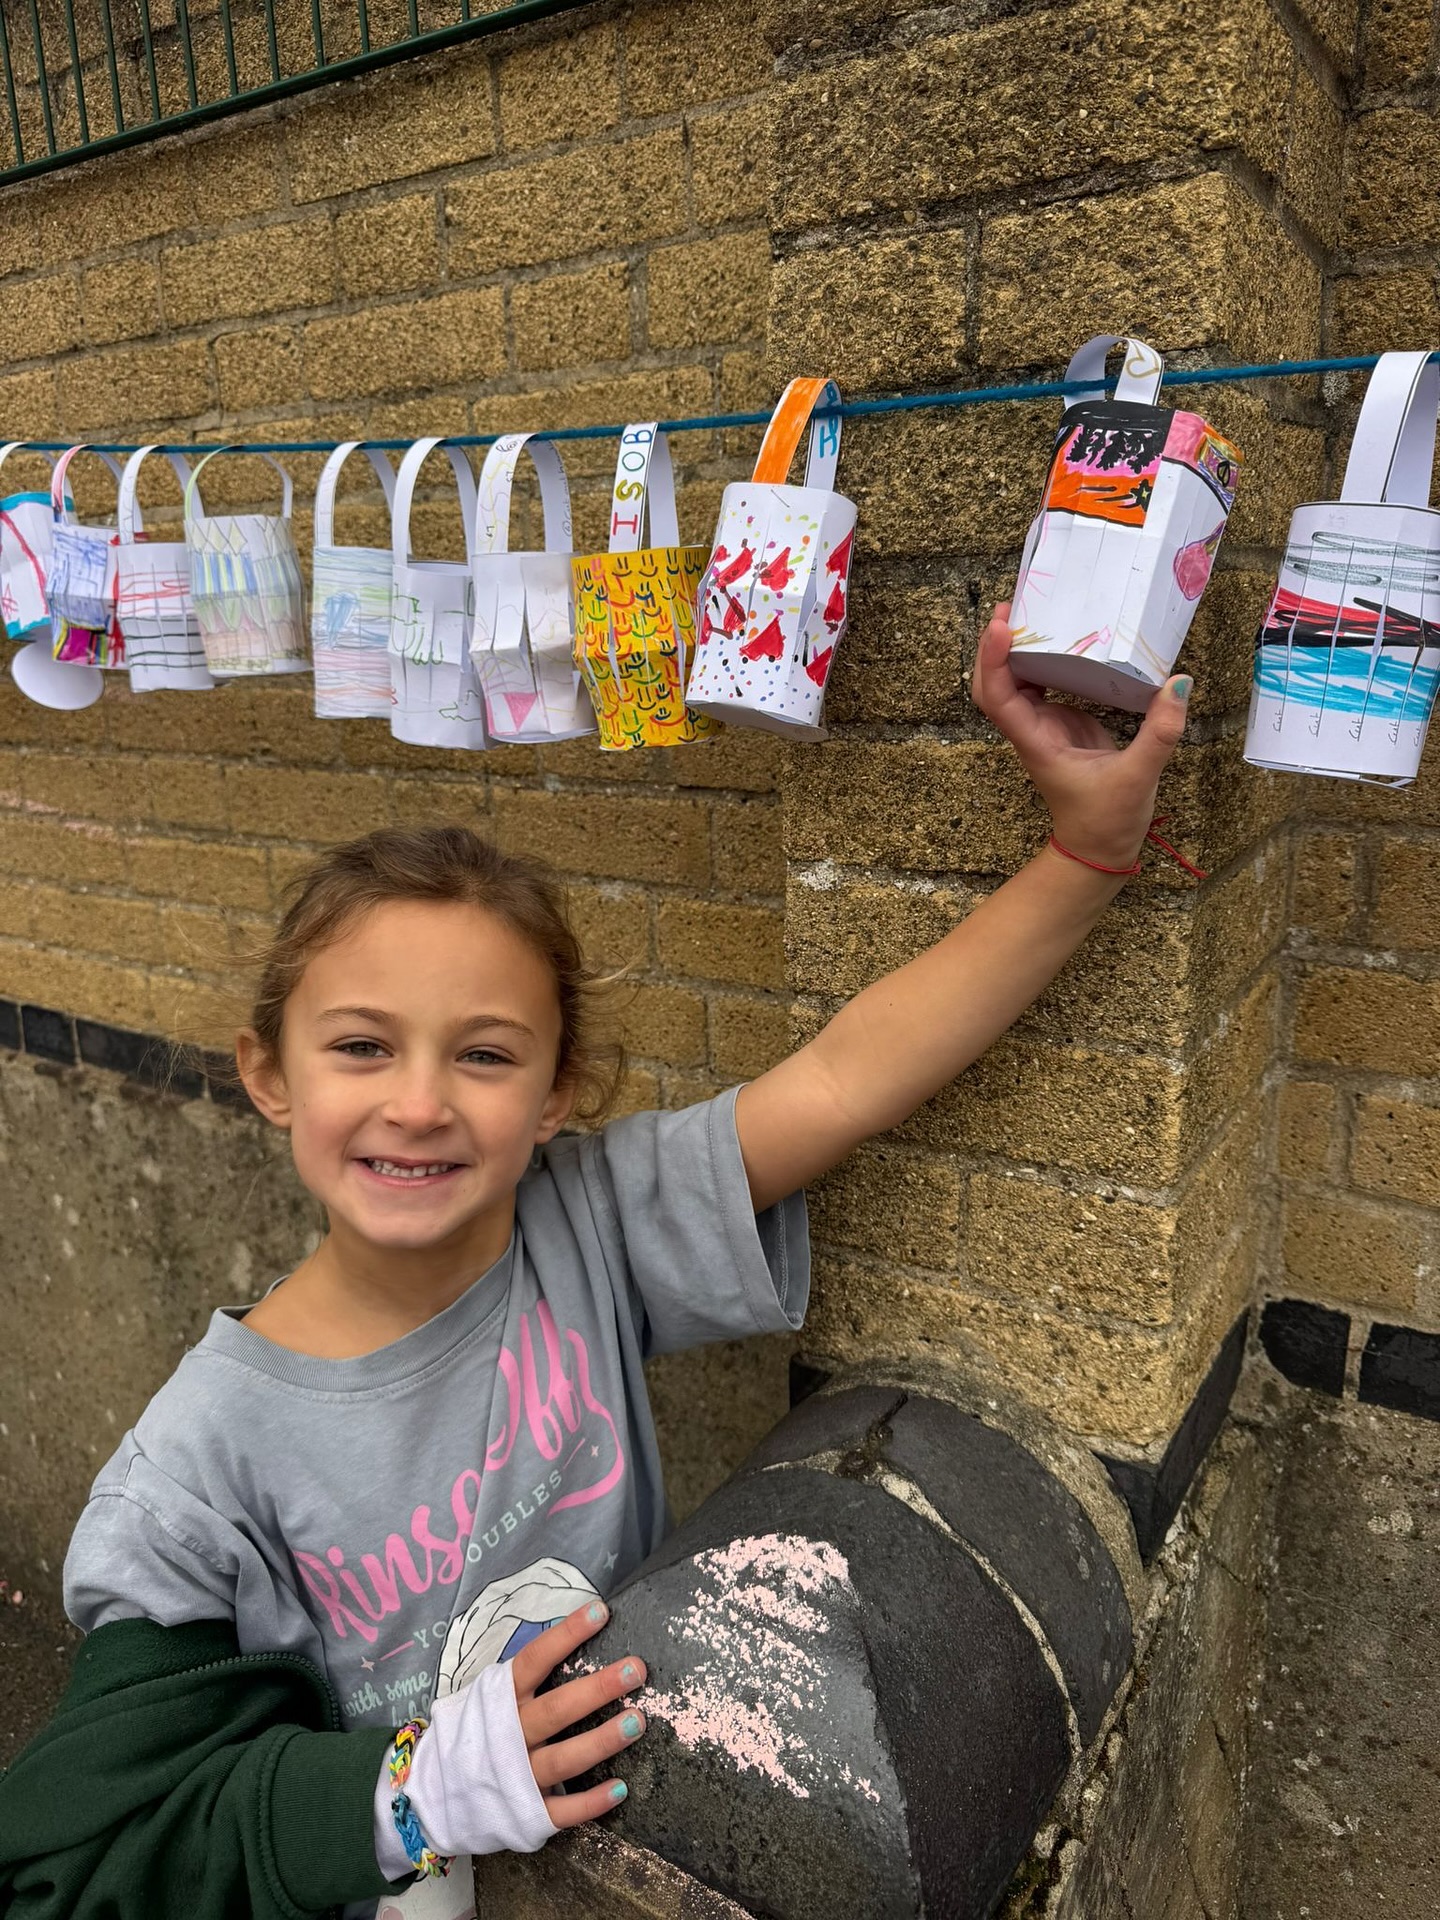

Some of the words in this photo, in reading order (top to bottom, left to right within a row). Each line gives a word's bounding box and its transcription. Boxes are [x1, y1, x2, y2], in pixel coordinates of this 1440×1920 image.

[612, 429, 652, 536] ISOB
[413, 1620, 448, 1649] YO
[466, 1469, 563, 1564] OUBLES
[342, 1681, 383, 1718] with
[385, 1671, 432, 1702] some
